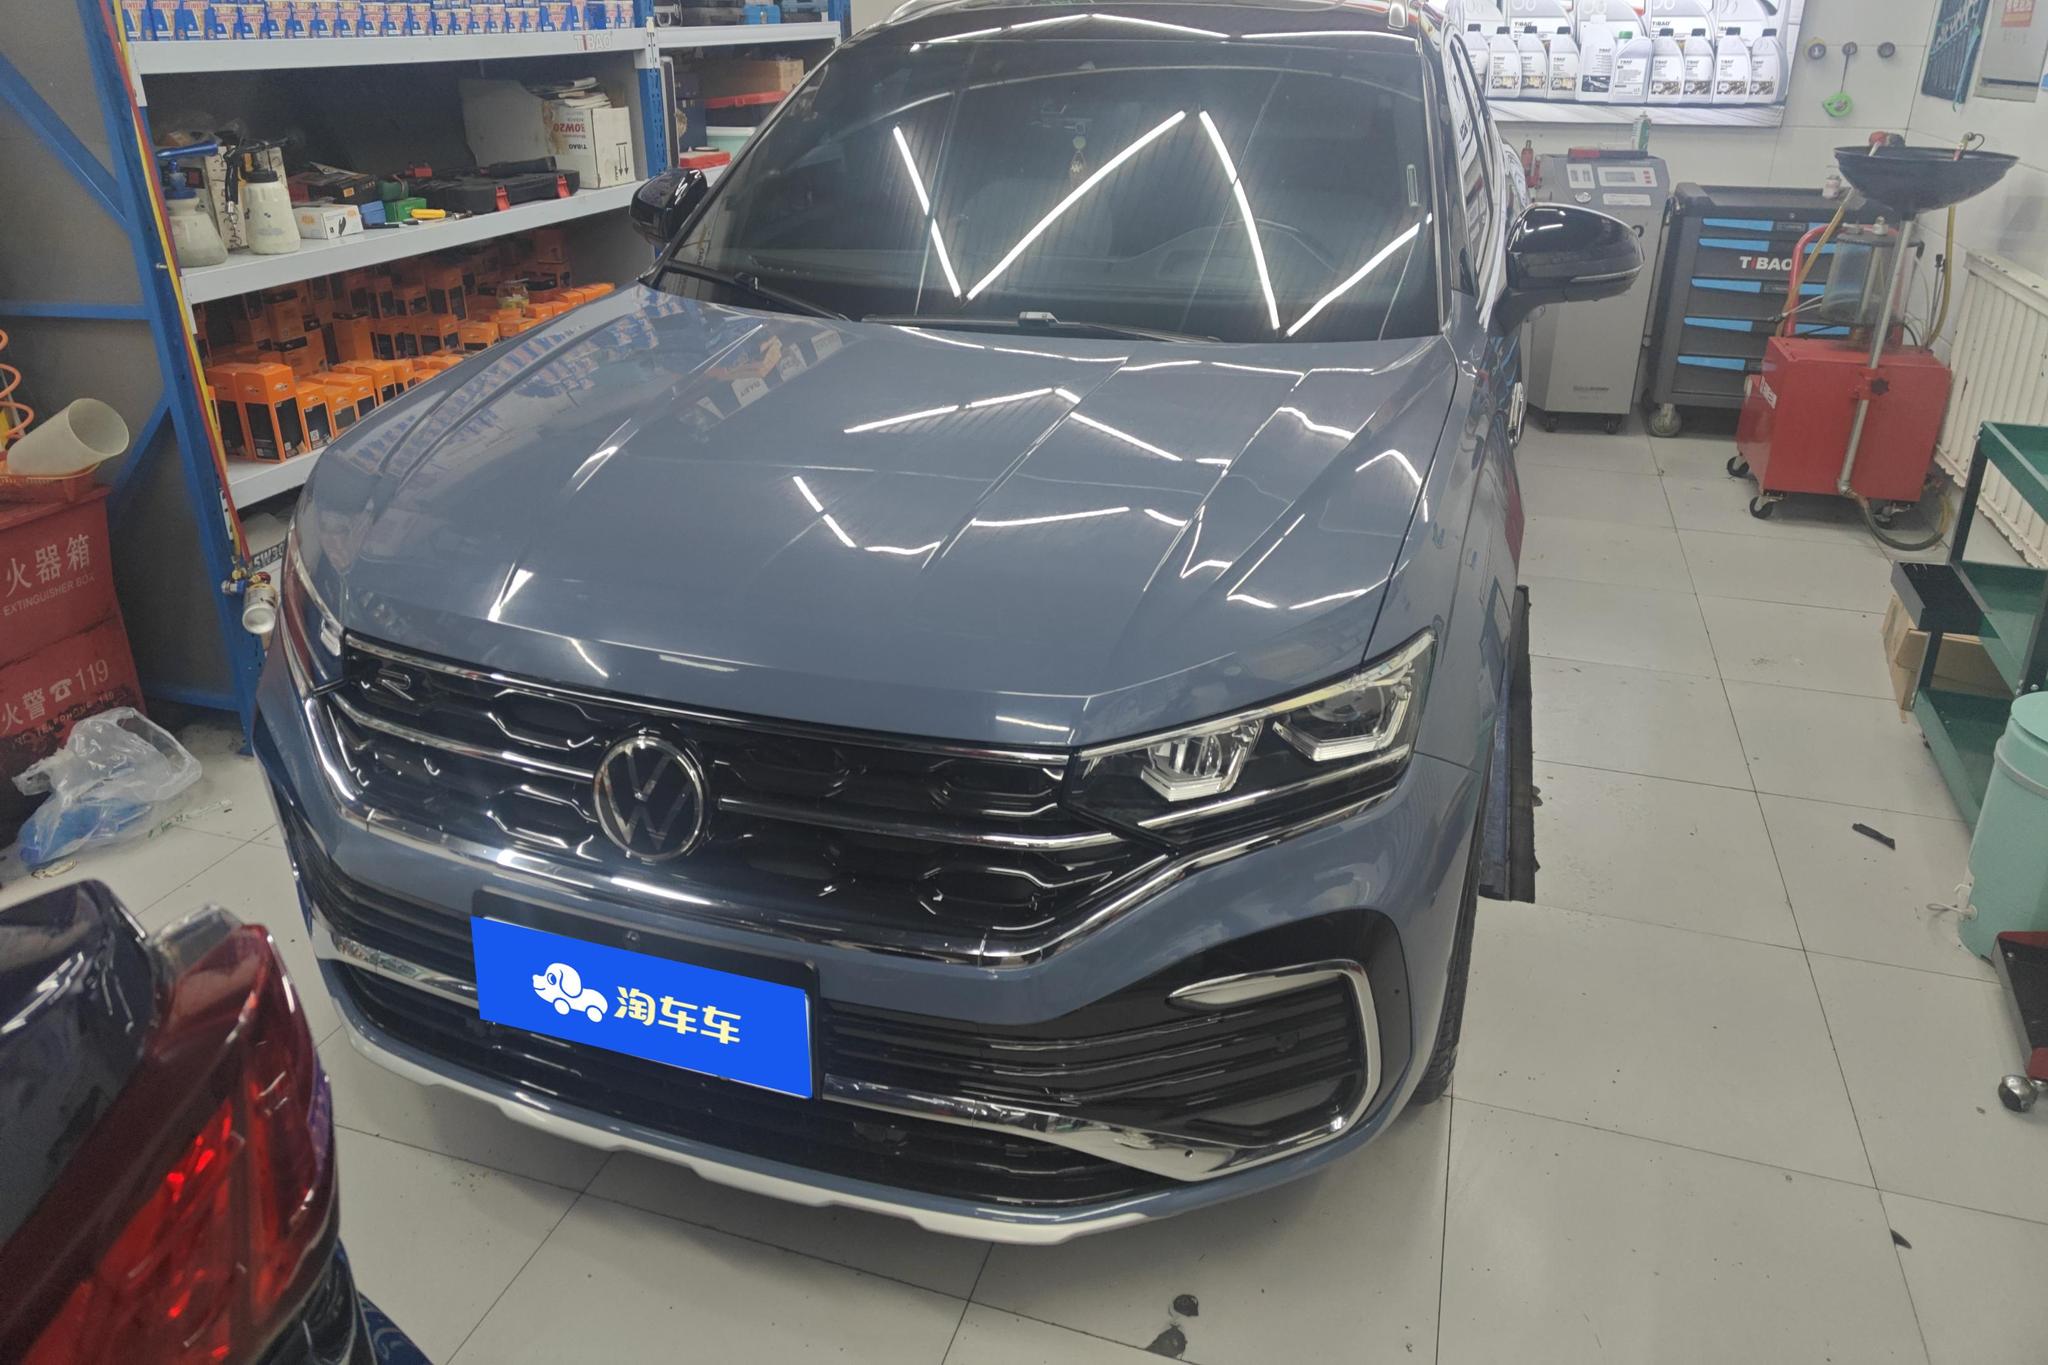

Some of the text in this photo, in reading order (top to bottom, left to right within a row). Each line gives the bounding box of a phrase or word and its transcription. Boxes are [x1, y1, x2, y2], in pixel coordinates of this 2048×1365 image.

[1739, 256, 1793, 271] TIBAO
[7, 534, 90, 598] 火器箱
[3, 580, 75, 616] EXTINGUISHER
[0, 659, 109, 736] 火警 119
